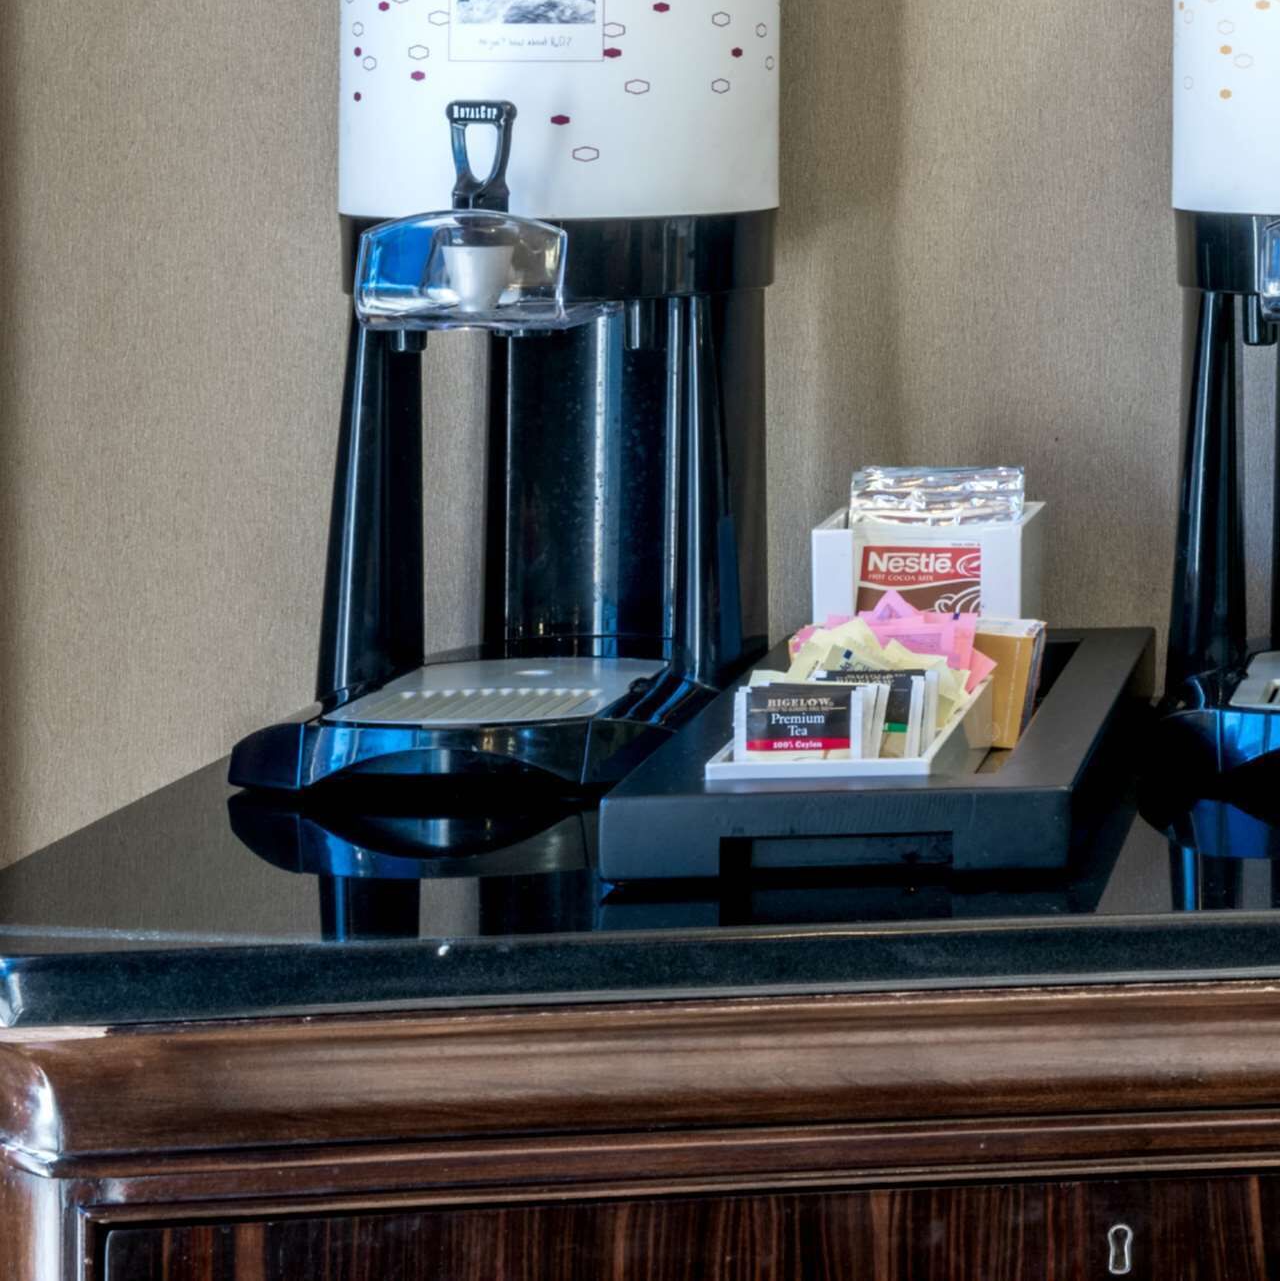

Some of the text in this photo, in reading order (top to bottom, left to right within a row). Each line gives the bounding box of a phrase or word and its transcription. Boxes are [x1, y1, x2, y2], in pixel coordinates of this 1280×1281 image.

[868, 551, 952, 574] Nestlé
[767, 697, 832, 707] BIGELOW
[770, 712, 825, 725] Premium
[787, 724, 808, 736] Tea
